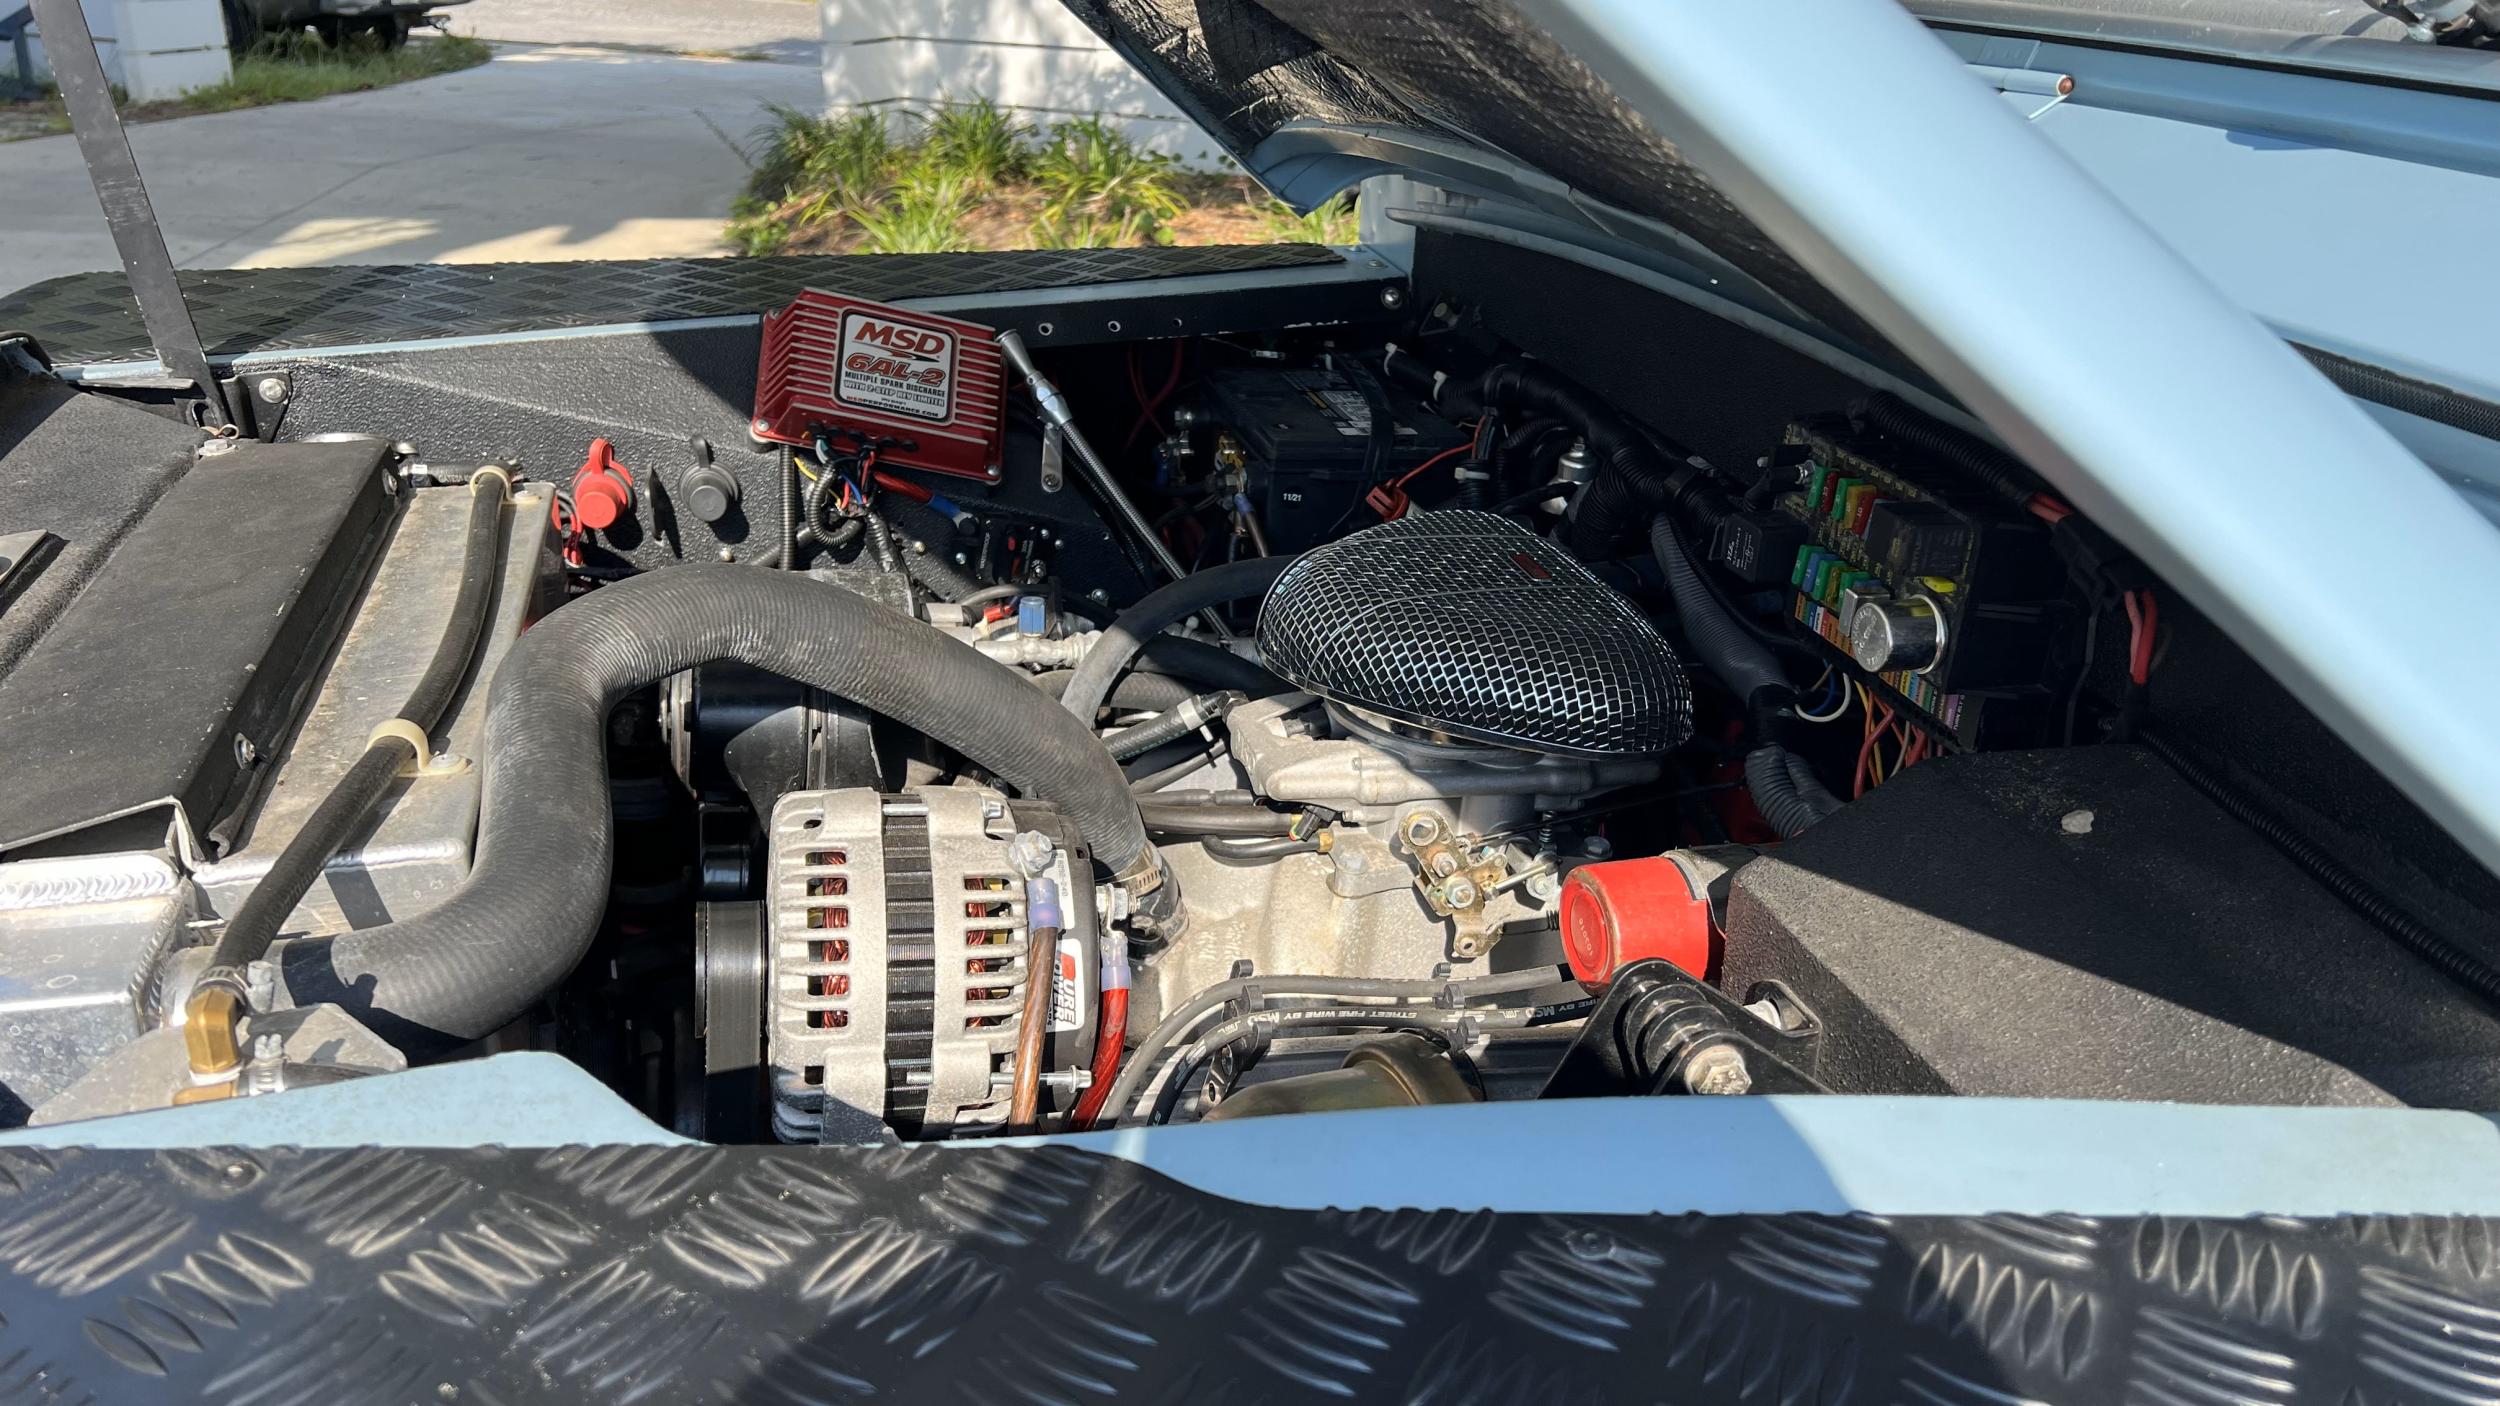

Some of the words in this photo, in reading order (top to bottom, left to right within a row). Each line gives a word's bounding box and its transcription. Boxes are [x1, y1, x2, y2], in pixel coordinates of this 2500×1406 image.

[854, 321, 945, 355] MSD
[845, 352, 946, 387] 6AL-2
[843, 380, 867, 392] WITH
[844, 371, 878, 384] MULTIPLE
[880, 378, 904, 388] SPARK
[906, 382, 946, 397] DISCHARGE
[1282, 492, 1302, 502] 11/21
[1283, 1011, 1303, 1021] BY
[1304, 1010, 1336, 1019] WIRE
[1337, 1010, 1367, 1019] FIRE
[1368, 1010, 1418, 1020] STREET
